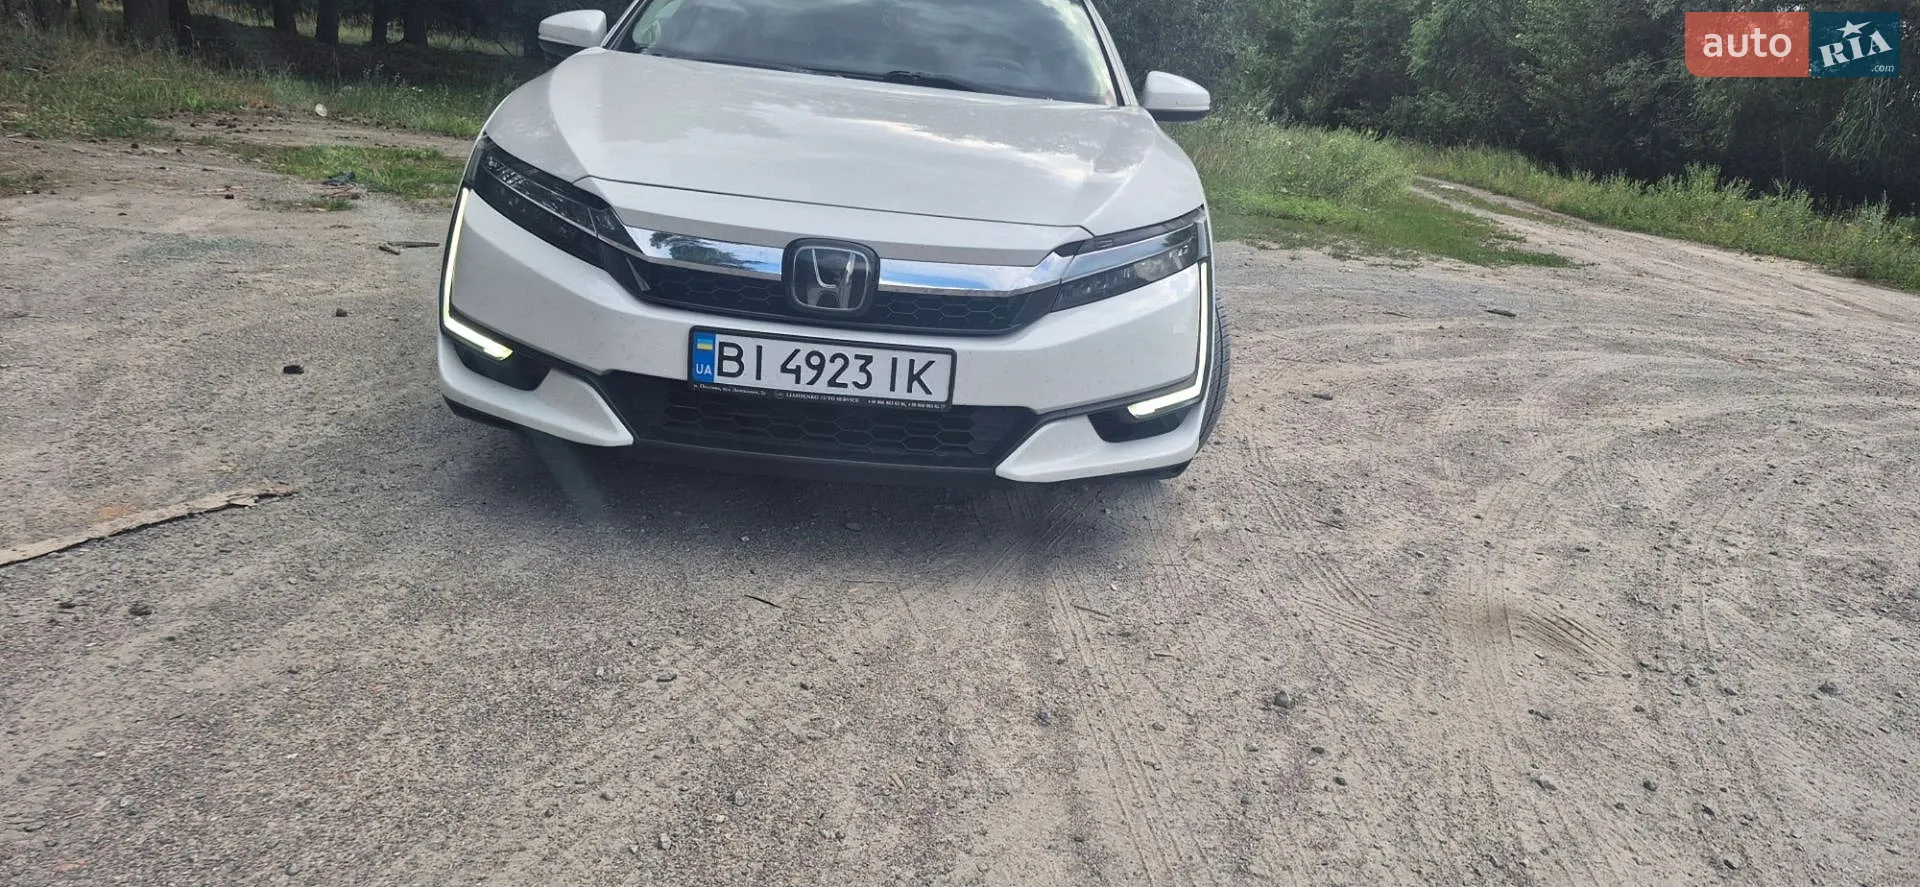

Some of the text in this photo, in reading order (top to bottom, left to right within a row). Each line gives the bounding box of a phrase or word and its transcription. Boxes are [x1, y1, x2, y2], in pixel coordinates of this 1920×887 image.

[695, 363, 713, 376] UA
[716, 341, 936, 395] BI 4923 IK
